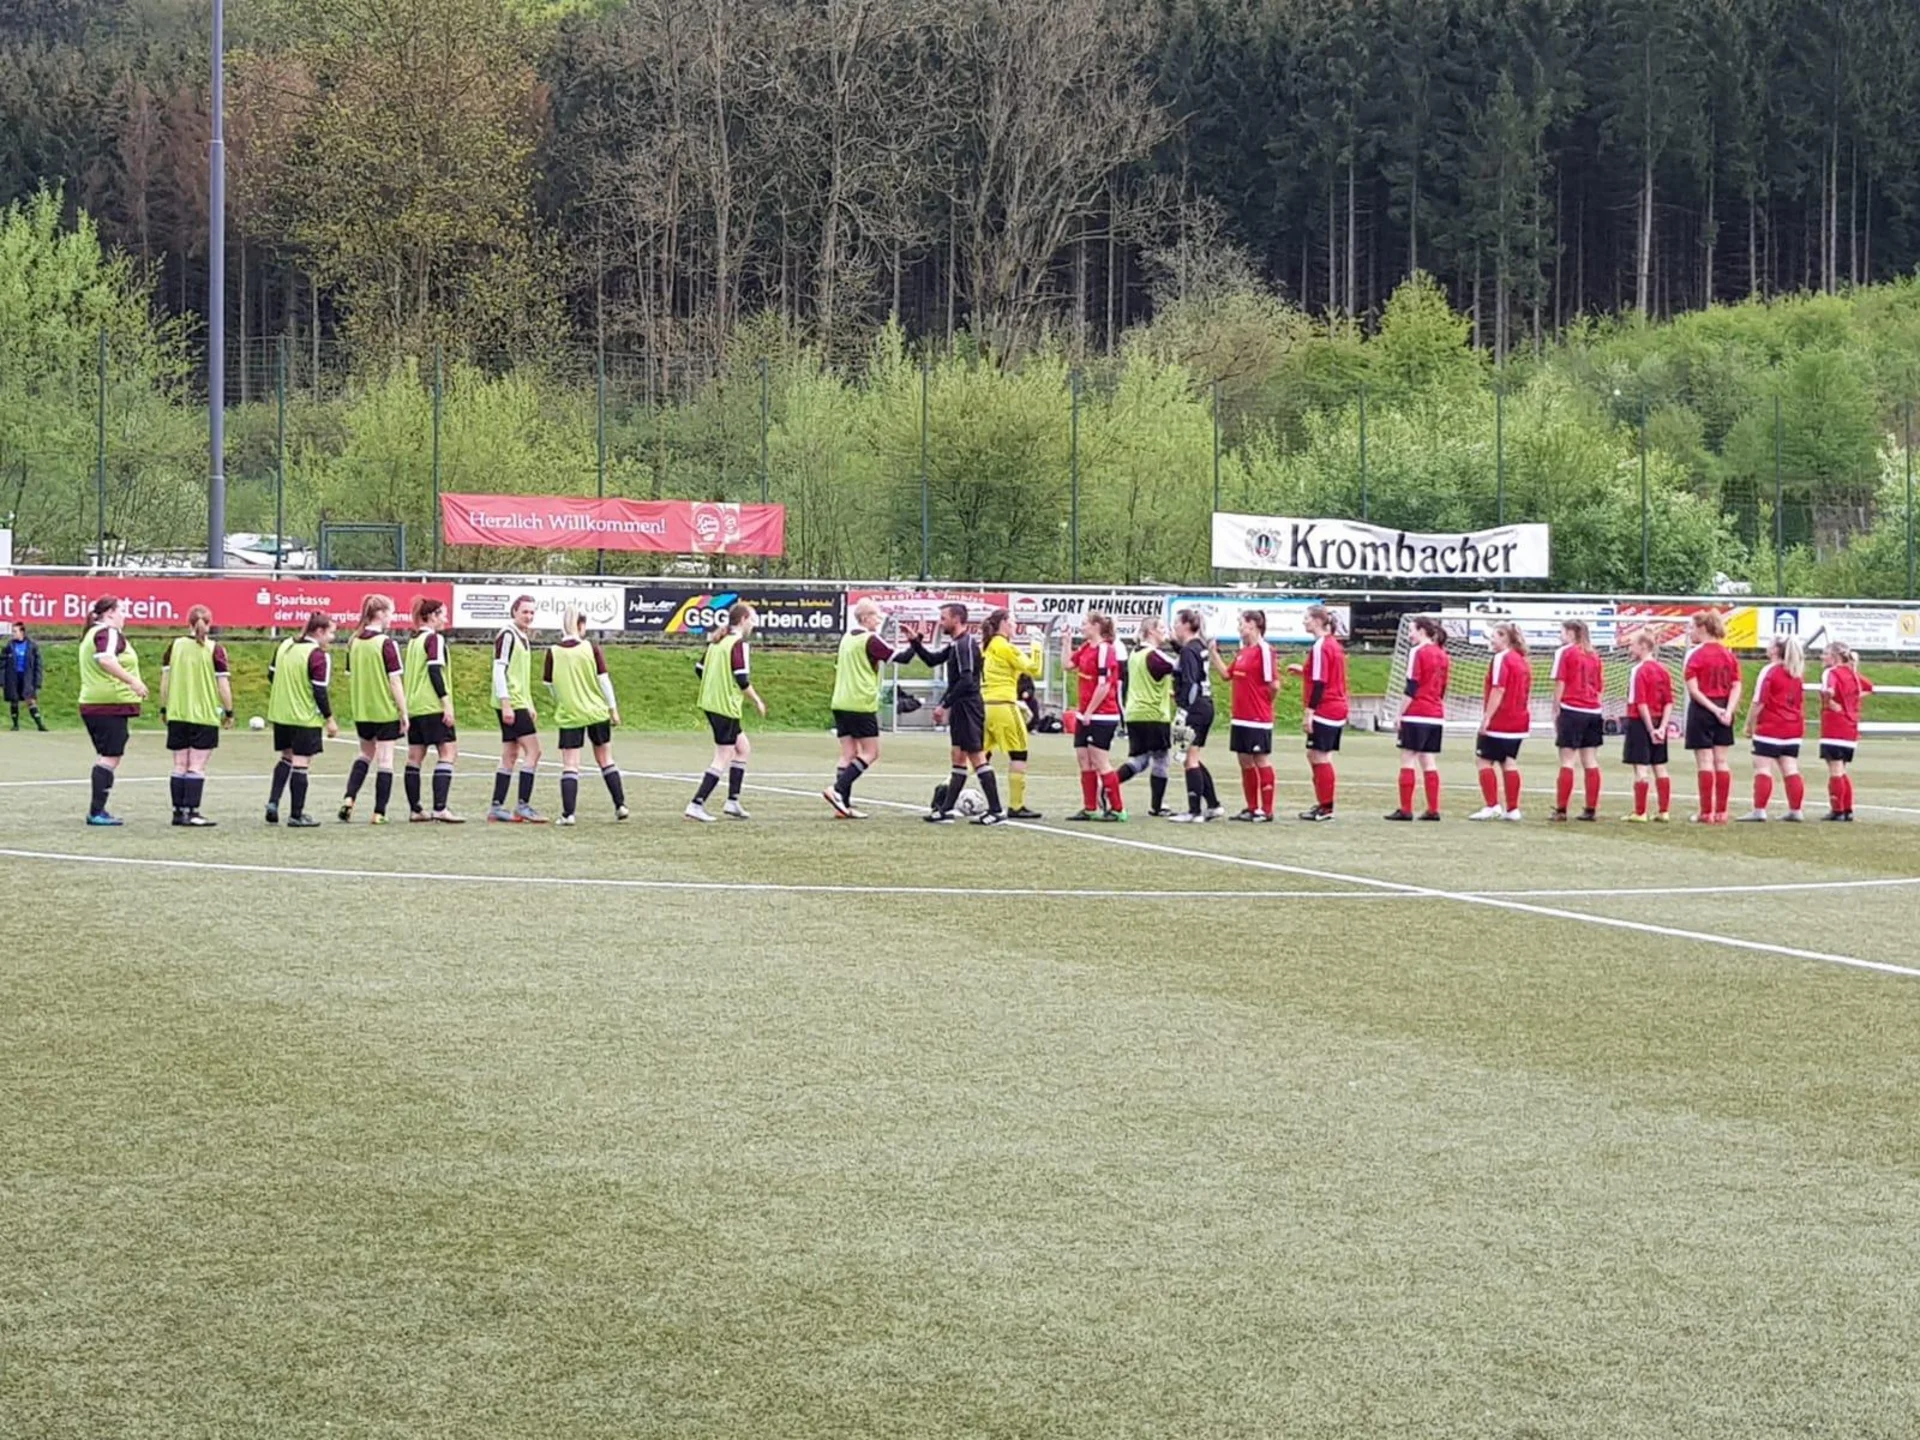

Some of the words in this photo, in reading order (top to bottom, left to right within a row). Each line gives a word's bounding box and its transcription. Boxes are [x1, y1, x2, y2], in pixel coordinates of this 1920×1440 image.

[469, 511, 542, 530] Herzlich
[548, 514, 666, 534] Willkommen!
[1290, 524, 1518, 573] Krombacher
[19, 592, 58, 617] für
[274, 593, 331, 606] Sparkasse
[1041, 597, 1085, 614] SPORT
[1088, 599, 1164, 616] HENNECKEN
[274, 610, 293, 620] der
